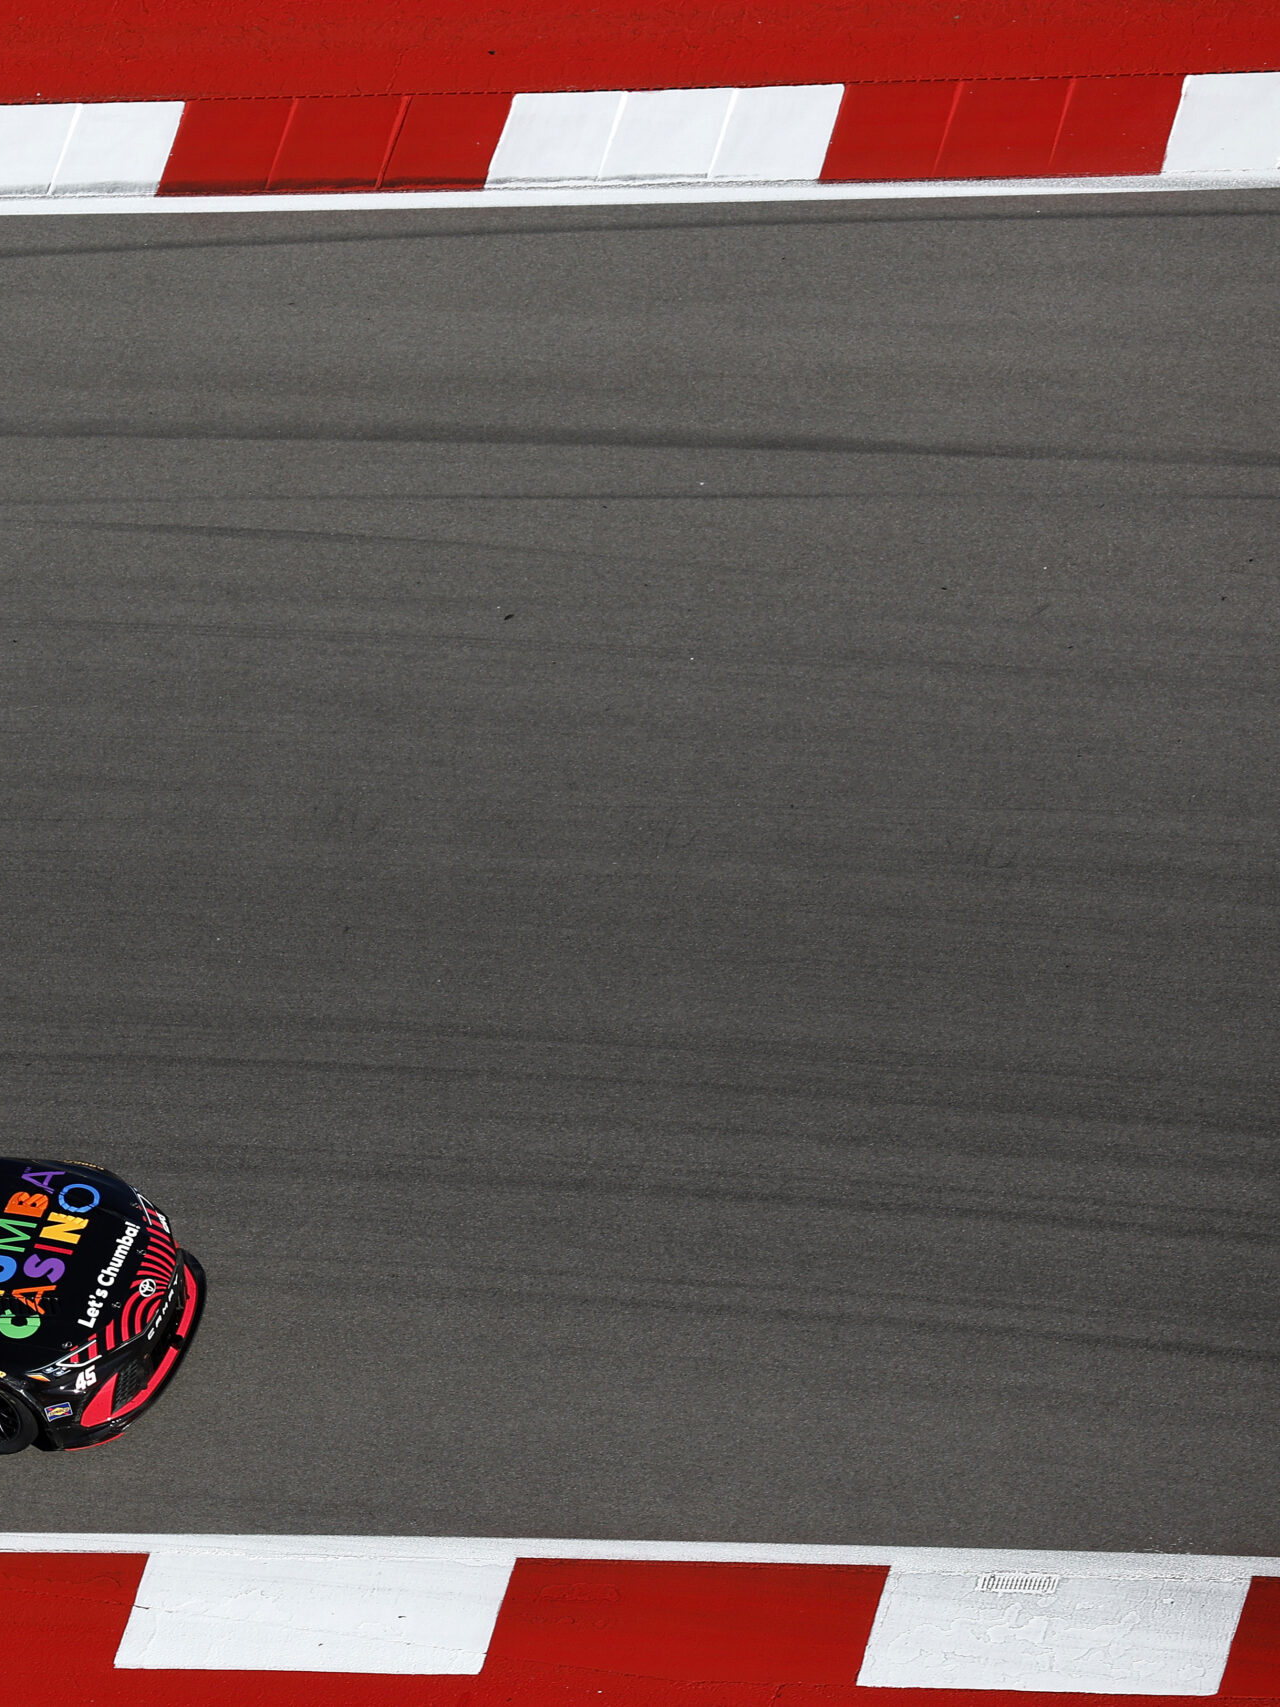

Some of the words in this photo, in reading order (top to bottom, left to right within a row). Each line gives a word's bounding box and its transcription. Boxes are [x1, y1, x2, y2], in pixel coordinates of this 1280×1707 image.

[77, 1288, 109, 1328] Let's
[97, 1221, 141, 1287] Chumba!
[75, 1364, 97, 1391] 45
